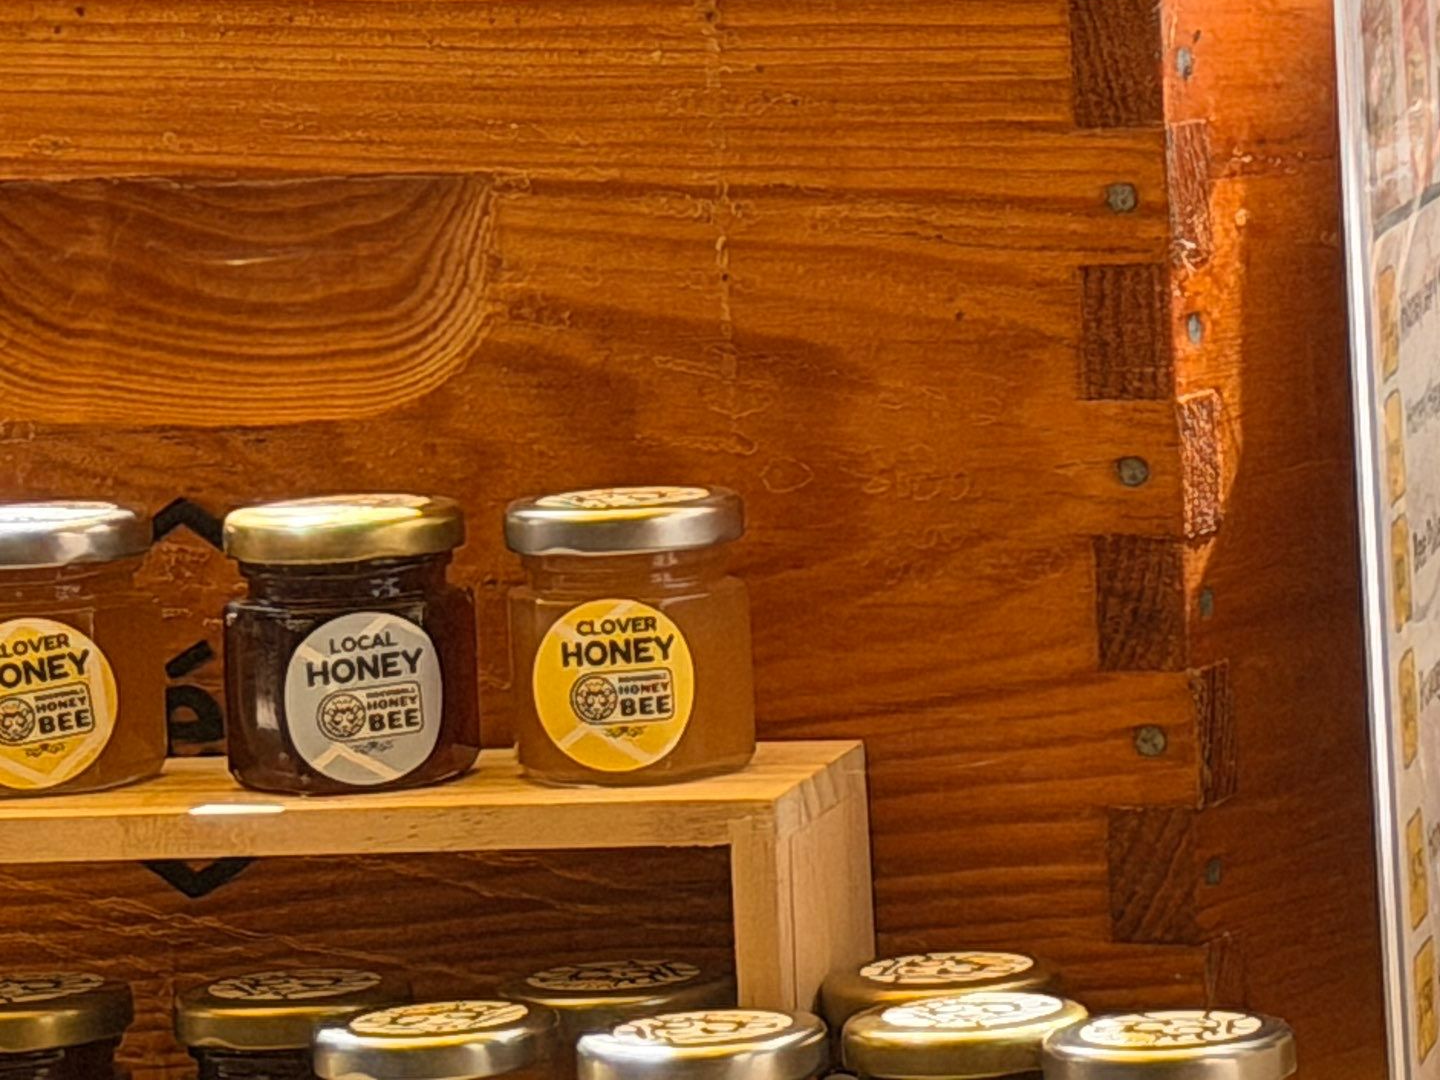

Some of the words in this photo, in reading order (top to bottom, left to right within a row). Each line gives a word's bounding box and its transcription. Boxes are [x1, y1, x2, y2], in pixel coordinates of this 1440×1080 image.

[576, 616, 658, 637] CLOVER
[329, 631, 399, 655] LOCAL
[561, 634, 675, 668] HONEY
[305, 647, 424, 688] HONEY
[617, 681, 671, 696] HONEY
[36, 695, 87, 714] HONEY
[366, 695, 418, 711] HONEY
[619, 695, 672, 717] BEE
[38, 709, 92, 735] BEE
[368, 707, 420, 732] BEE
